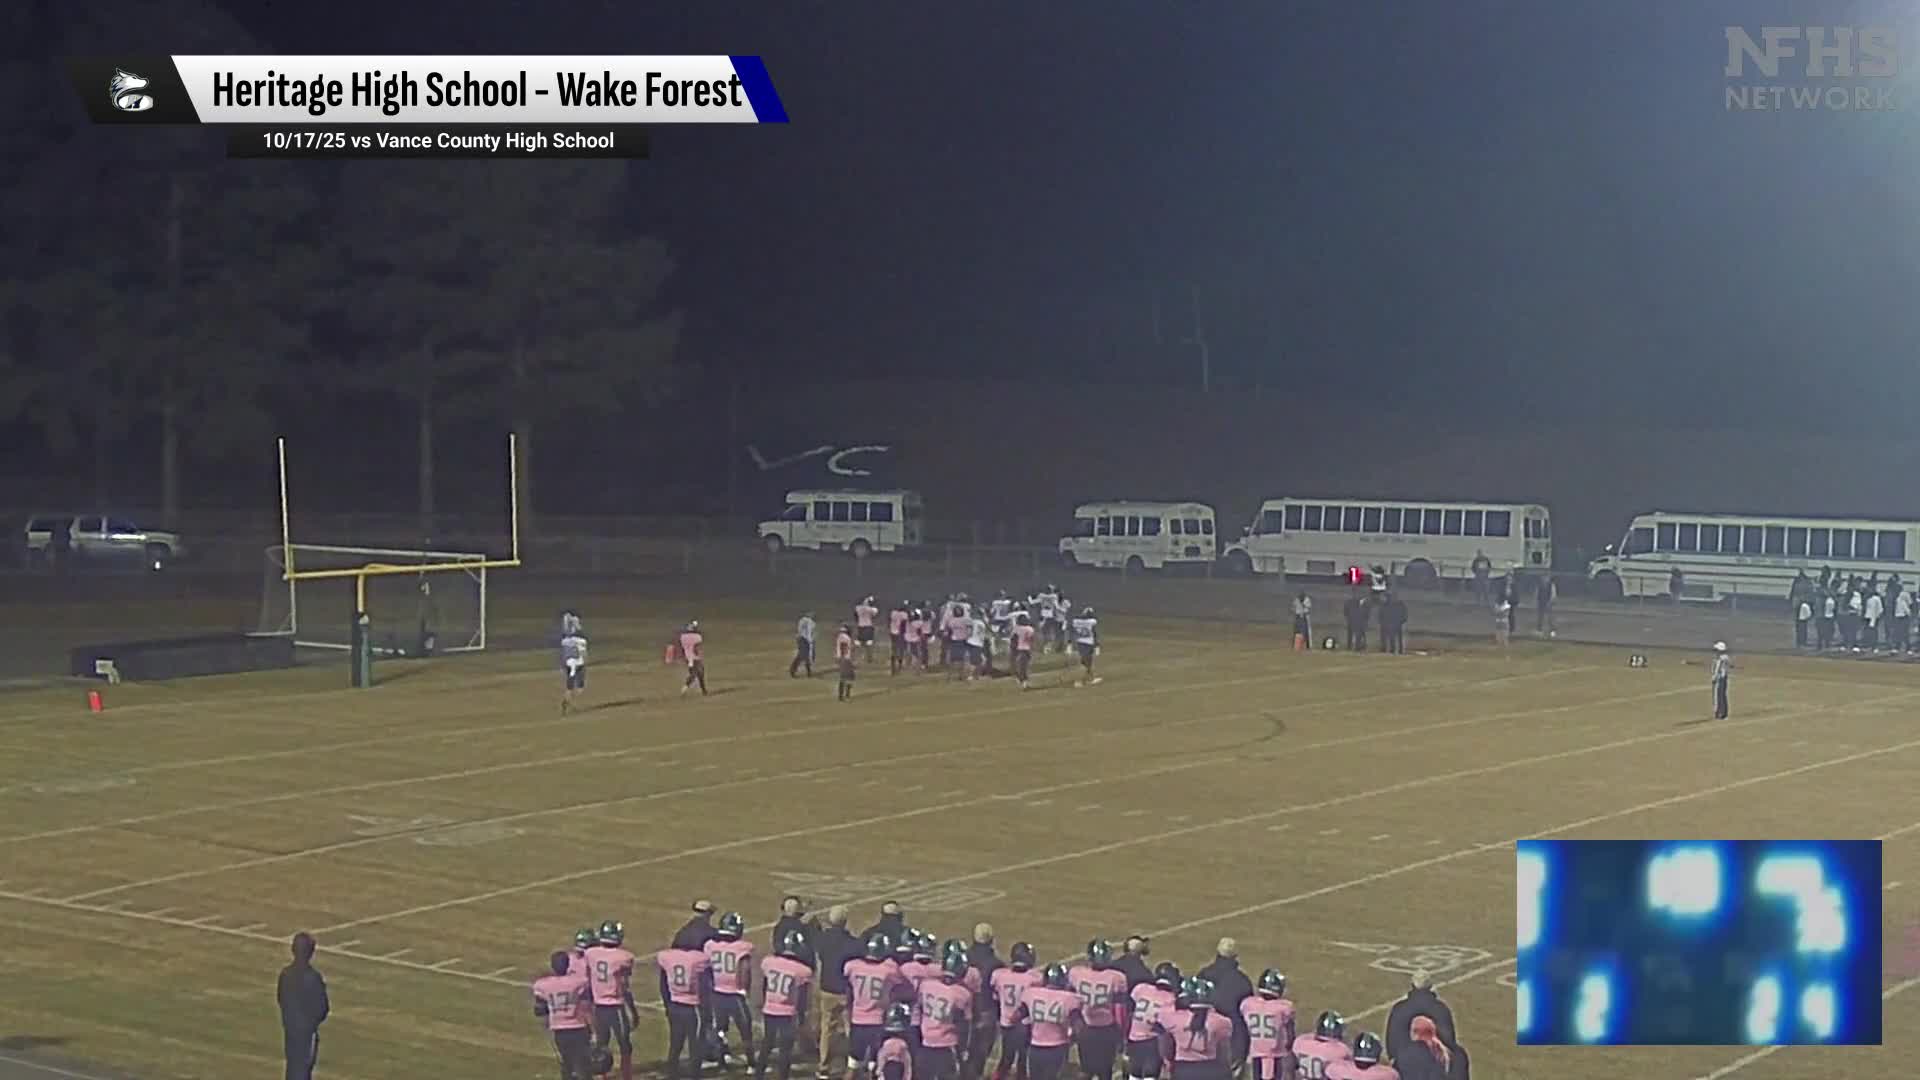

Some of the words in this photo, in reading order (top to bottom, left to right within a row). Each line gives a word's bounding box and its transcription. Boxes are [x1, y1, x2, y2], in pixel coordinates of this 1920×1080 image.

[596, 960, 609, 983] 9
[710, 951, 736, 974] 20
[672, 964, 686, 987] 8
[767, 969, 795, 995] 30
[855, 975, 884, 1000] 76
[1078, 980, 1110, 1007] 52
[1031, 999, 1064, 1024] 64
[1249, 1014, 1277, 1039] 25
